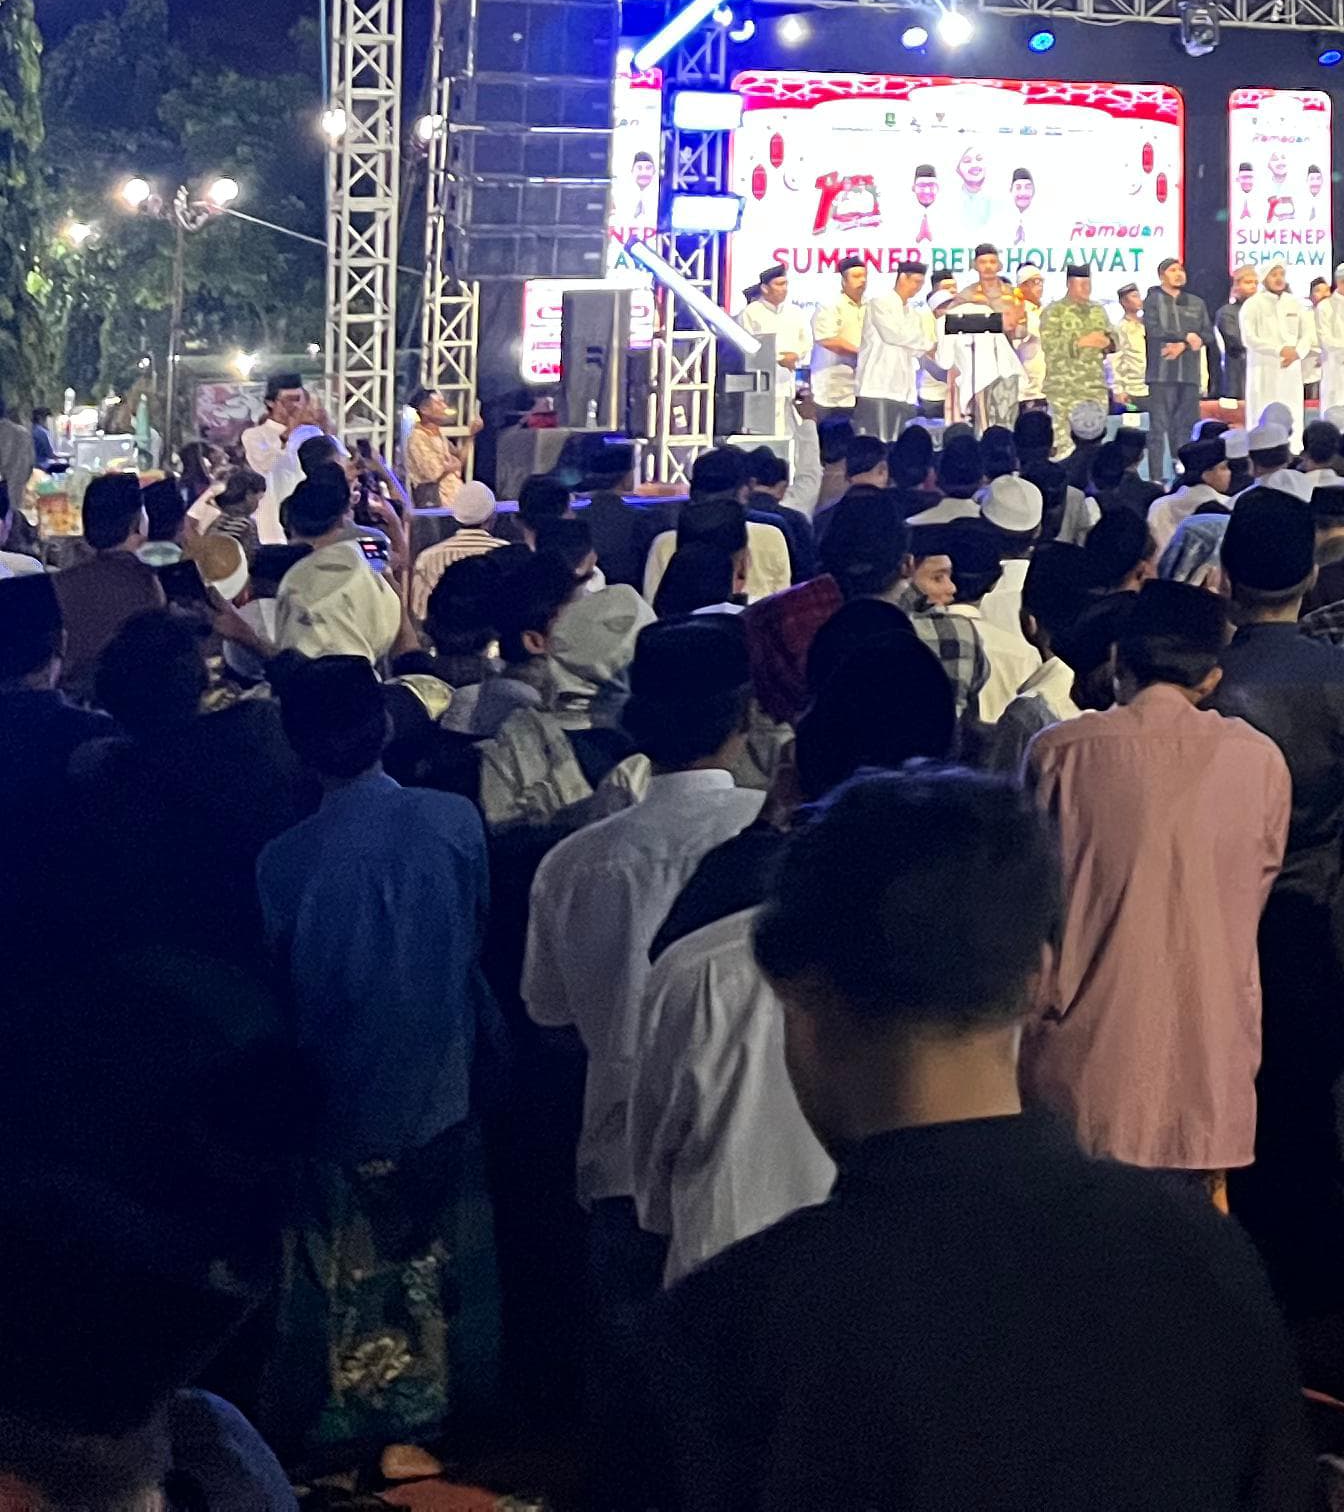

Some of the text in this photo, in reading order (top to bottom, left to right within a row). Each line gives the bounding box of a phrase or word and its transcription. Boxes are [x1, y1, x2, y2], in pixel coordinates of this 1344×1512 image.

[1070, 221, 1164, 241] Ramadan
[1237, 230, 1326, 245] SUMENEP
[932, 247, 1144, 273] BEHOLAWAT
